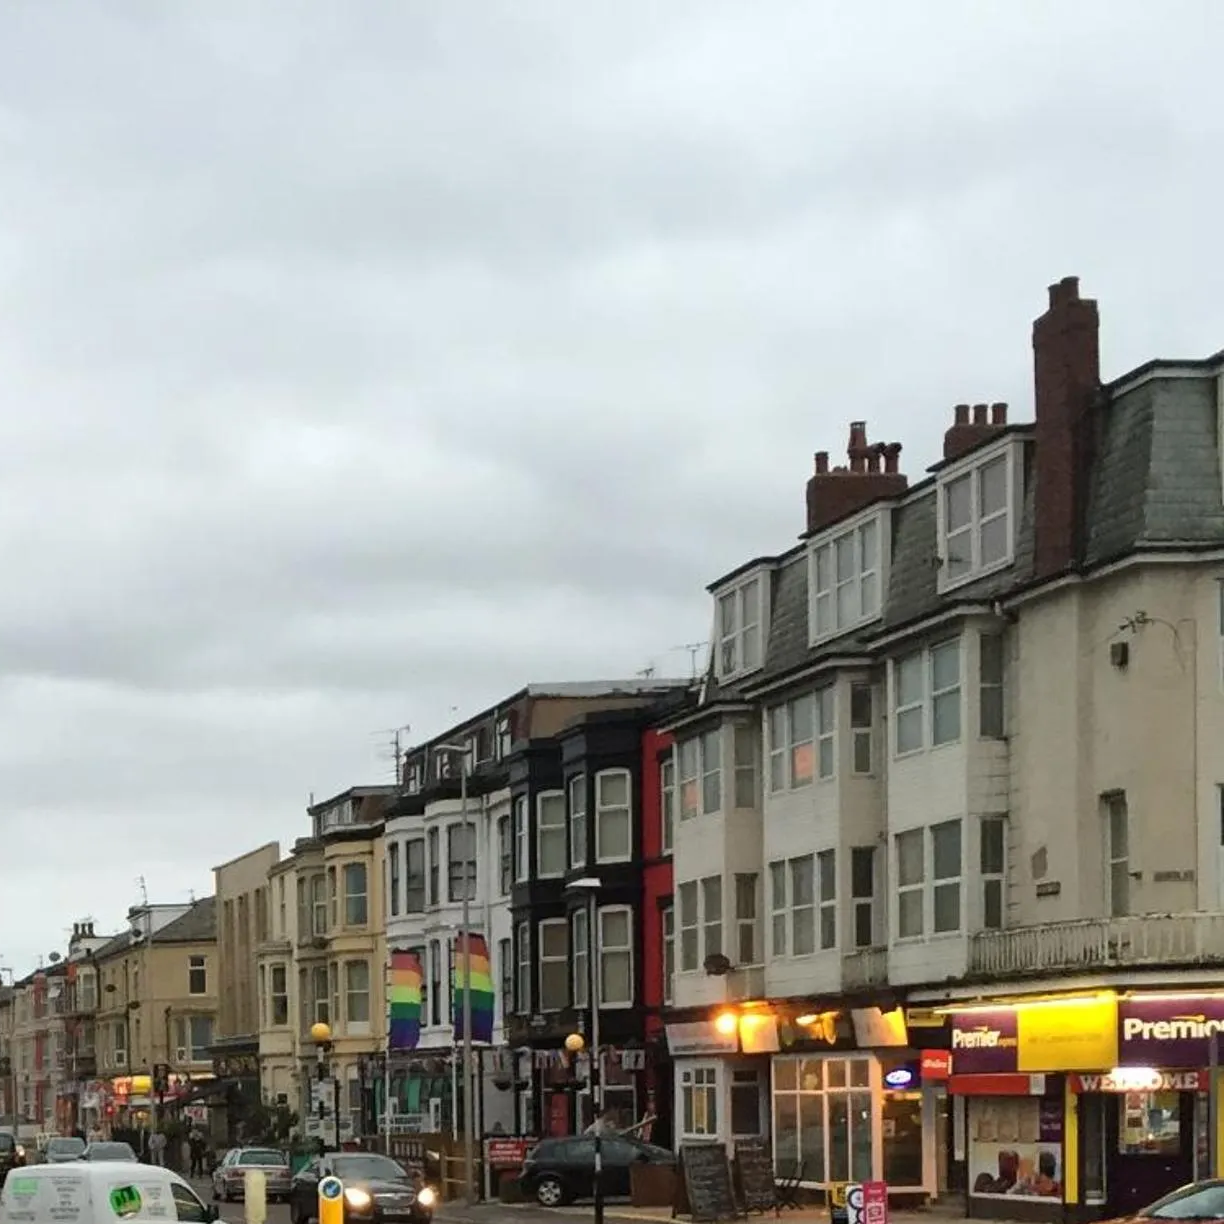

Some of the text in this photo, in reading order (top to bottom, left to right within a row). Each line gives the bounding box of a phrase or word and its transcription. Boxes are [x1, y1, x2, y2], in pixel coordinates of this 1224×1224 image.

[952, 1025, 1001, 1048] Premier
[1124, 1014, 1224, 1040] Premie
[1079, 1070, 1199, 1093] WEOME
